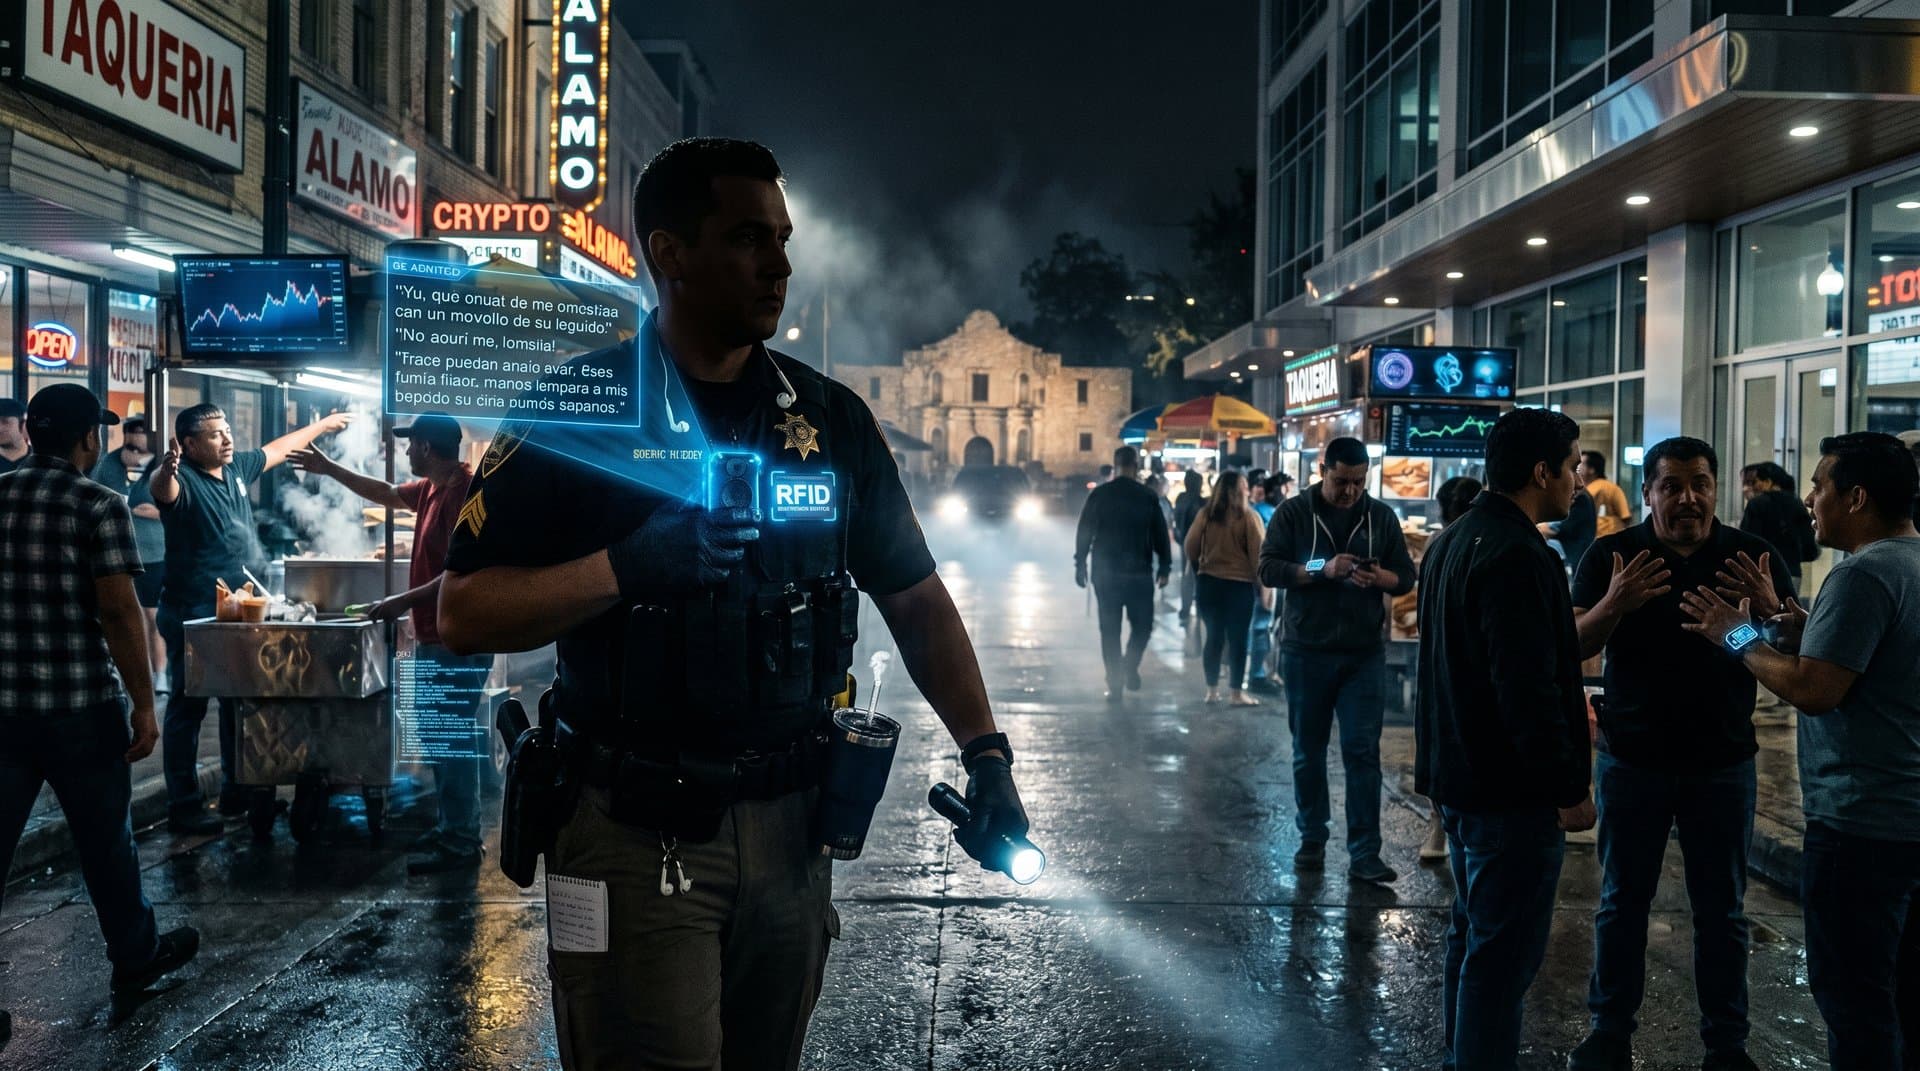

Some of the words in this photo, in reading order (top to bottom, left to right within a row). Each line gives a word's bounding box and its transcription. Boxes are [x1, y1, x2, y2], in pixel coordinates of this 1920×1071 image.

[560, 0, 597, 189] ALAMO
[304, 127, 410, 220] ALAMO
[432, 202, 551, 232] CRYPTO
[574, 208, 628, 276] ALAMO
[1881, 267, 1920, 306] TO
[510, 296, 528, 309] de
[532, 300, 554, 312] me
[394, 307, 422, 319] can
[428, 310, 446, 320] un
[450, 312, 509, 326] movollo
[514, 314, 530, 328] de
[534, 318, 552, 330] su
[28, 329, 74, 360] OPEN
[396, 328, 425, 342] "No
[430, 332, 468, 344] aouri
[446, 356, 498, 371] puedan
[484, 378, 532, 391] manos
[593, 385, 601, 395] a
[606, 384, 628, 397] mis
[1286, 358, 1338, 405] TAQUERIA
[455, 394, 472, 406] su
[776, 484, 830, 504] RFID
